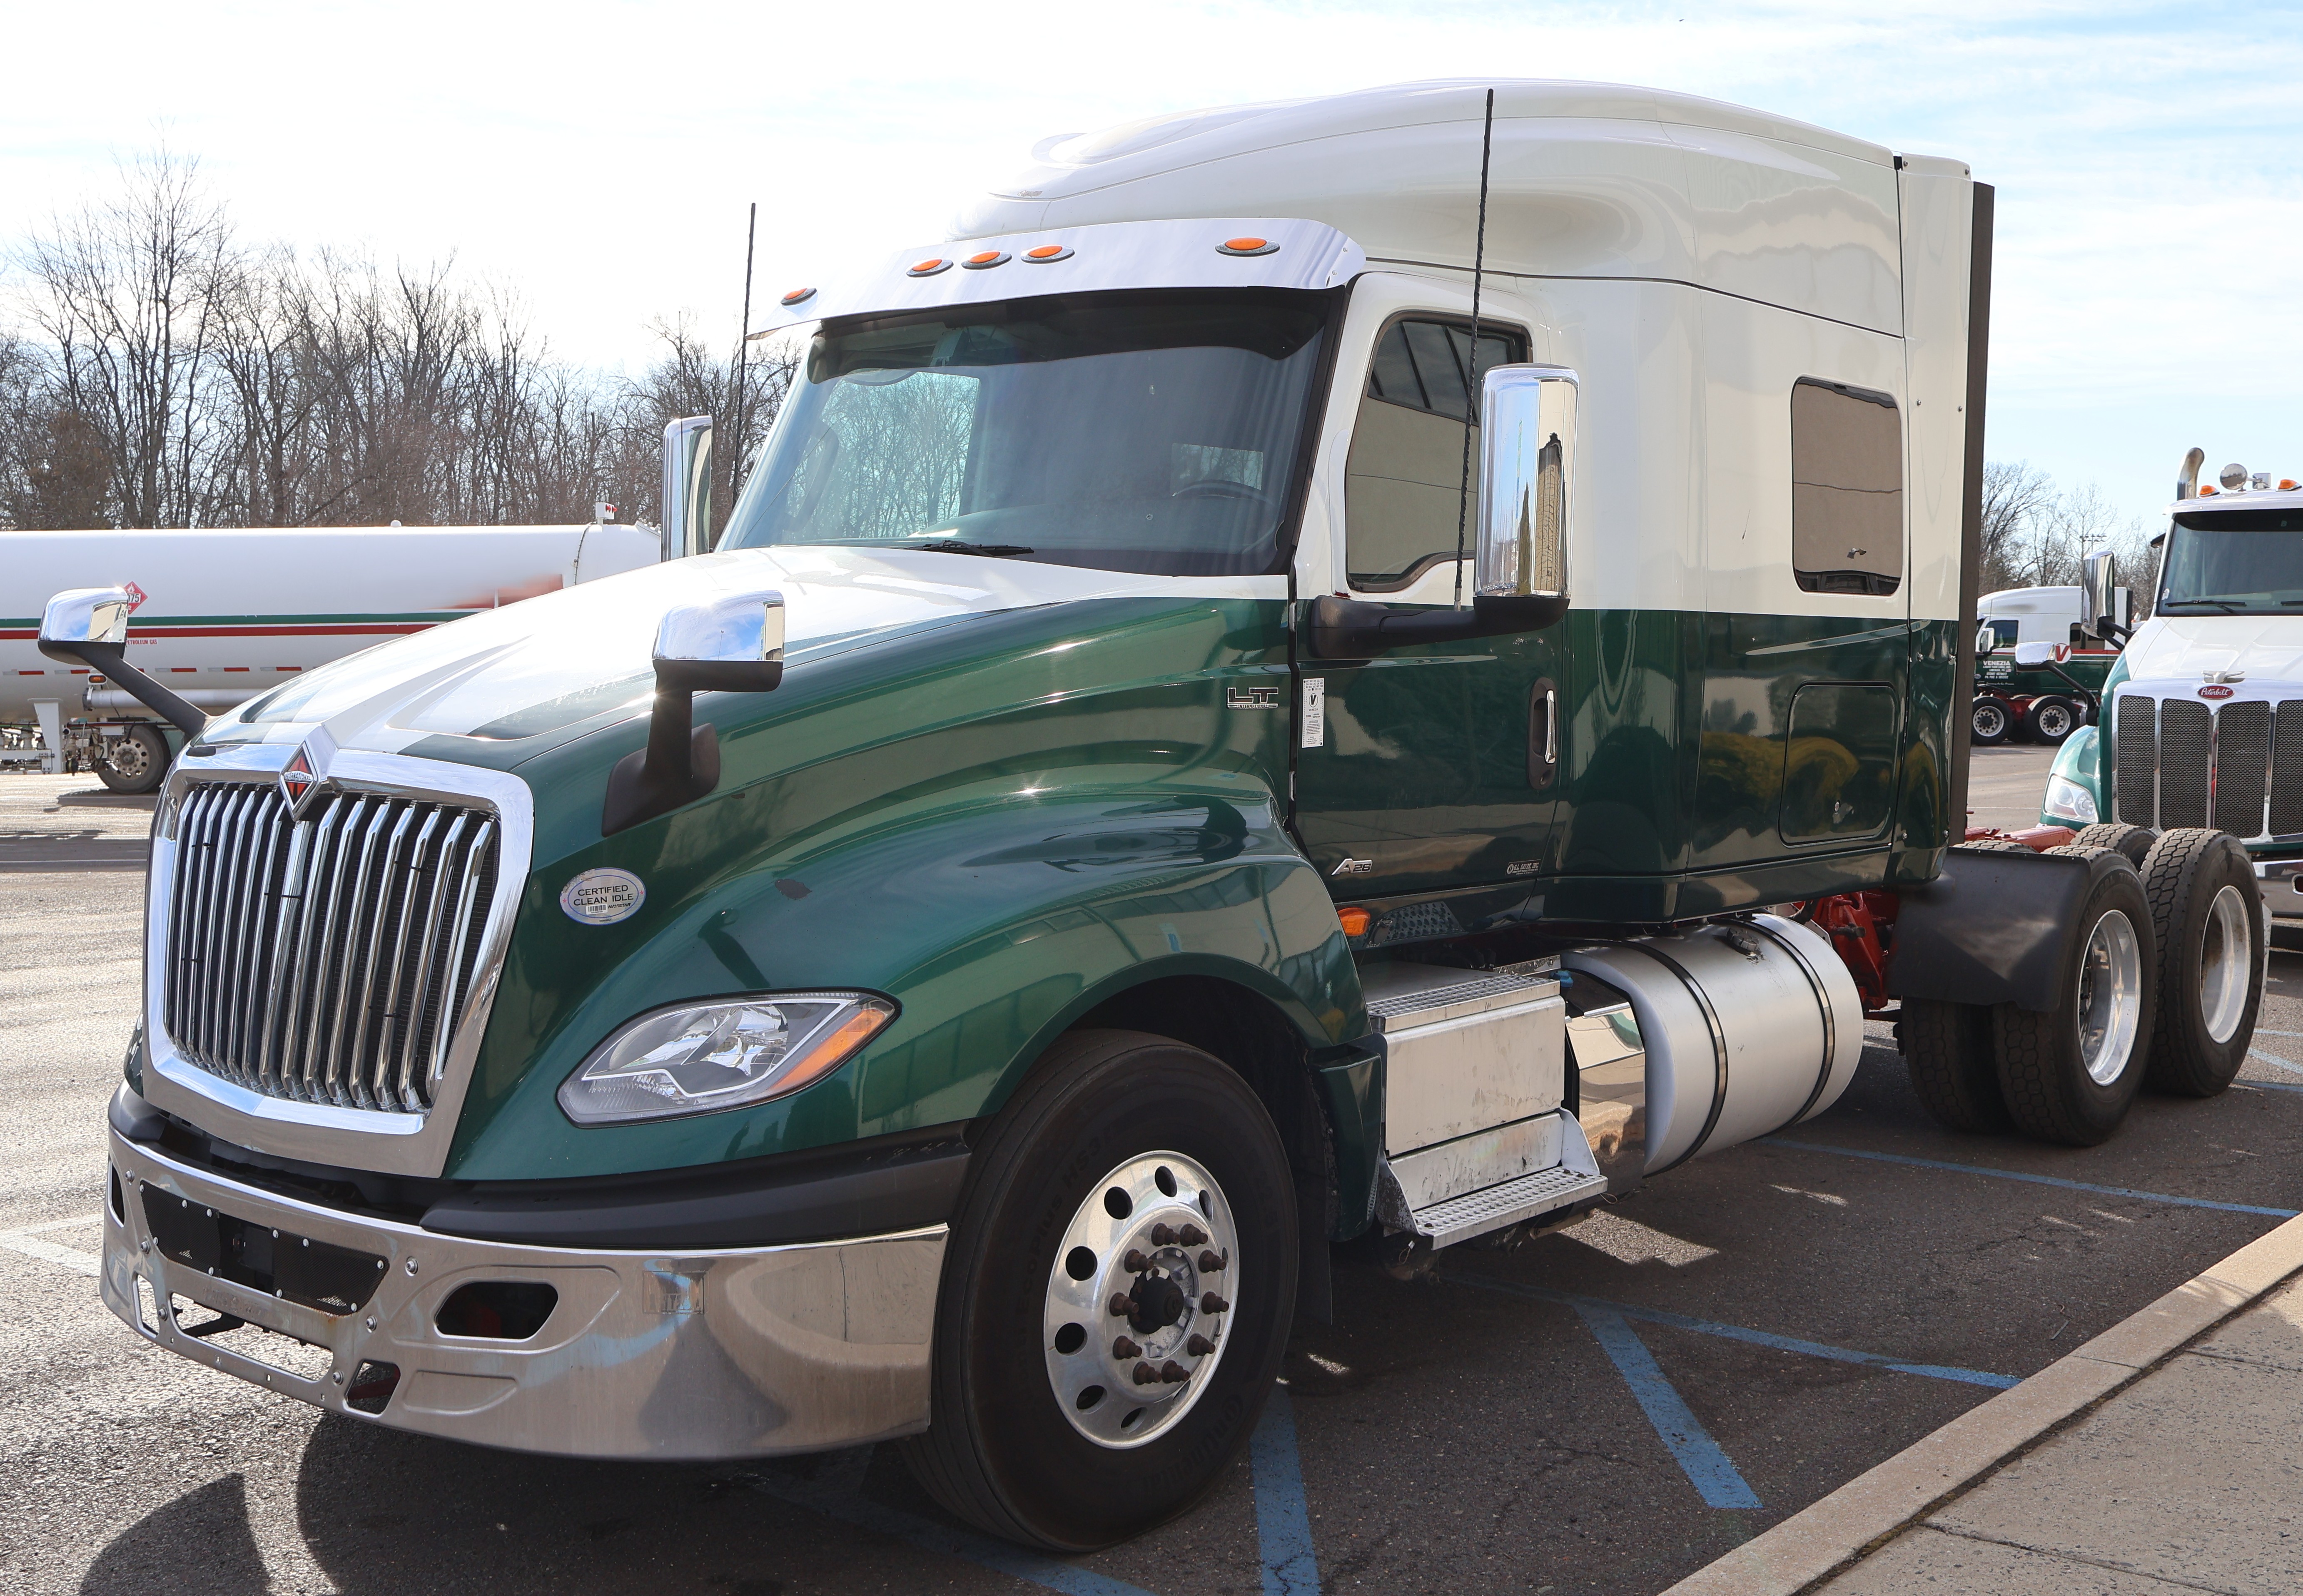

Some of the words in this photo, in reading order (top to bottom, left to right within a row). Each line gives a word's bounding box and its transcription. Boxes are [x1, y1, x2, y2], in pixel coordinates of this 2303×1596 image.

[1227, 687, 1279, 703] LT
[2201, 687, 2231, 696] Peterbilt
[1331, 858, 1373, 875] A26
[578, 885, 628, 896] CERTIFIED
[573, 896, 607, 906] CLEAN
[612, 893, 634, 902] IDLE
